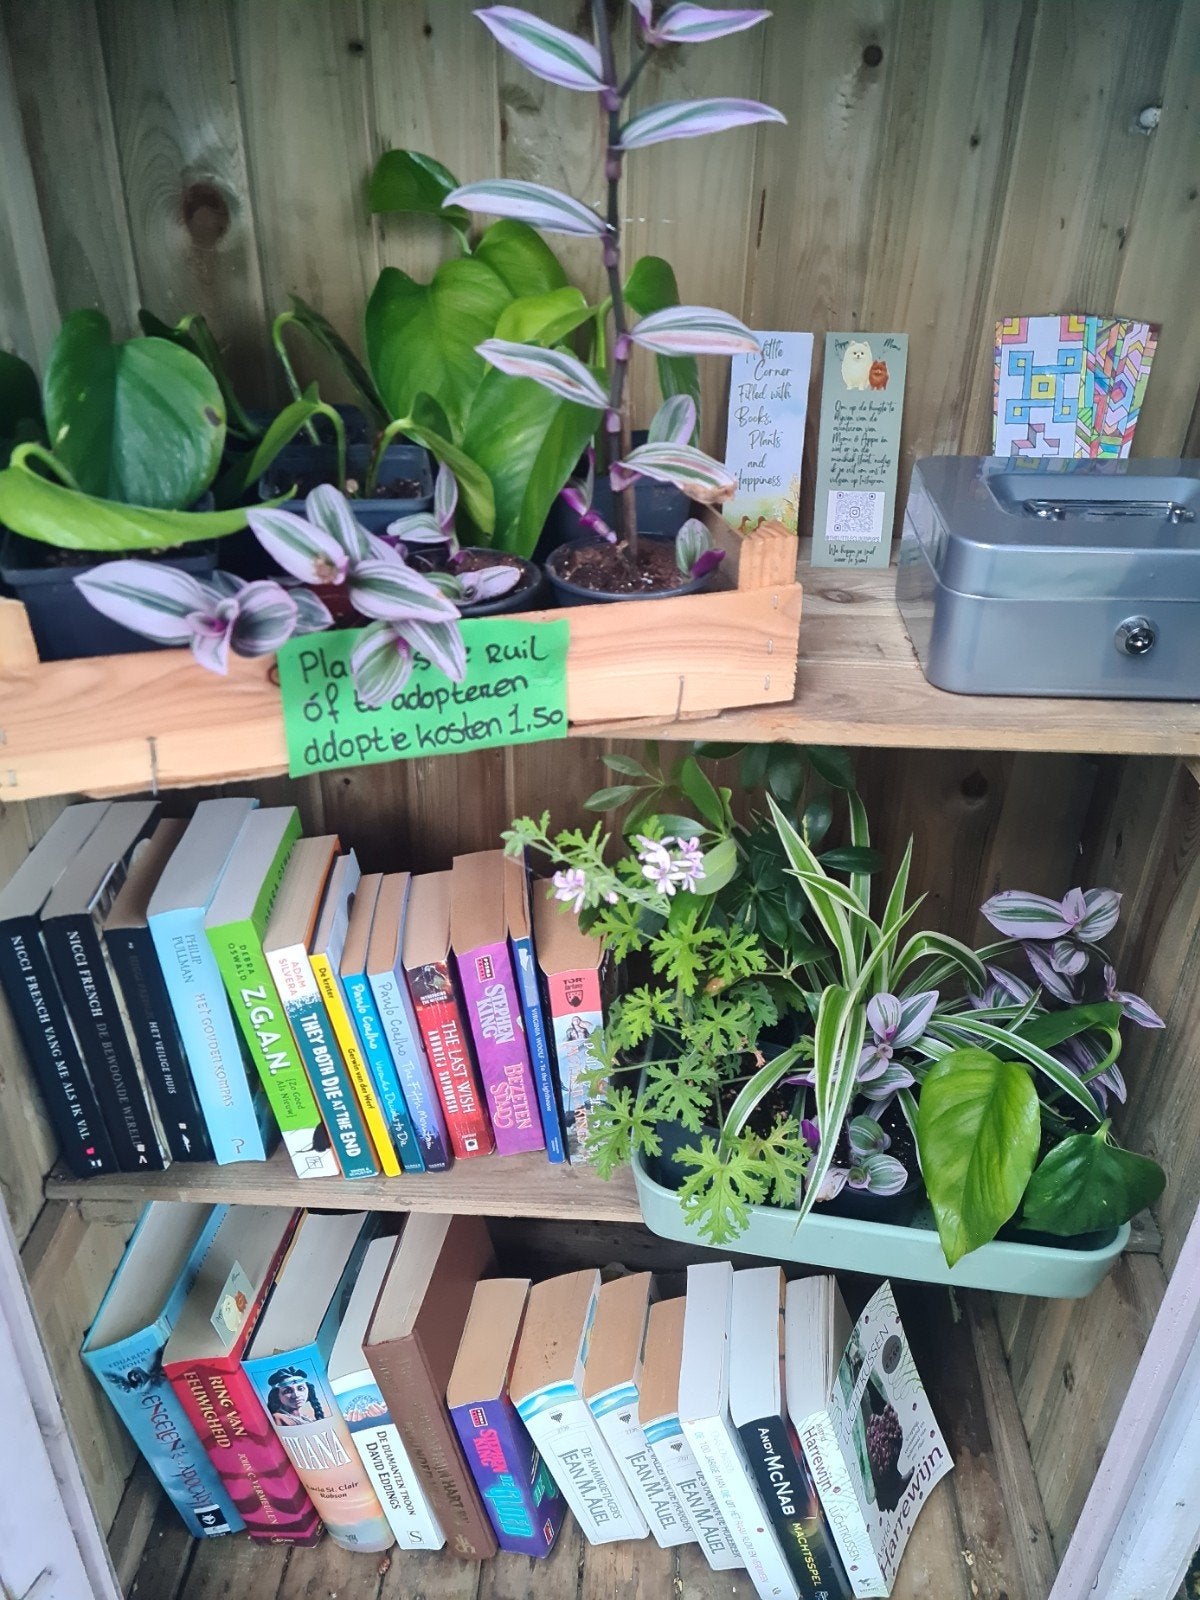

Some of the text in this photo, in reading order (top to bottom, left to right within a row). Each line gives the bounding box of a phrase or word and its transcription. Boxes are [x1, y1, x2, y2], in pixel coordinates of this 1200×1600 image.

[754, 358, 793, 381] Corner
[738, 382, 792, 403] Filled with
[749, 430, 783, 449] Plants
[748, 453, 767, 469] and
[172, 937, 194, 984] PULLMAN
[185, 934, 202, 965] PHILIP
[227, 942, 248, 981] OSWALD
[239, 943, 256, 975] DEBRA
[279, 958, 298, 997] SILVERA
[291, 961, 306, 988] ADAM
[318, 967, 334, 999] De krater
[563, 977, 582, 985] TOR
[66, 931, 130, 1104] NICCI FRENCH DE BEWOONDE
[476, 1000, 498, 1040] KING
[485, 984, 516, 1044] STEPHEN
[11, 935, 90, 1140] NICCI FRENCH VANG ME ALS IK VAL
[240, 984, 291, 1077] Z.G.A.N.
[379, 982, 393, 1015] Paulo
[391, 1019, 406, 1056] Coelho
[401, 1060, 415, 1086] The
[441, 1020, 460, 1048] THE
[531, 1008, 541, 1034] VIRGINIA
[536, 1034, 544, 1059] WOOLF
[540, 1064, 546, 1072] To
[149, 1022, 177, 1094] HET VEILIGE HUIS
[352, 984, 366, 1014] Paulo
[362, 1016, 378, 1050] Coelho
[397, 1130, 409, 1148] Die
[448, 1050, 468, 1077] LAST
[300, 1013, 362, 1158] THEY BOTH DIE AT THE END
[348, 1048, 360, 1073] Gerwin
[364, 1091, 375, 1110] Werf
[457, 1083, 476, 1114] WISH
[504, 1062, 532, 1130] BEZETEN
[108, 1348, 151, 1369] EDUARDO
[184, 1372, 231, 1448] EEUWIGHEID
[209, 1376, 247, 1436] RING VAN
[282, 1426, 353, 1471] TIANA
[581, 1446, 593, 1458] DE
[758, 1428, 775, 1455] ANDY
[376, 1430, 417, 1517] DE DIAMANTEN TROON
[558, 1448, 585, 1480] JEAN
[625, 1450, 654, 1482] JEAN
[802, 1426, 832, 1493] Harrewijn
[338, 1481, 359, 1491] Clair
[366, 1442, 401, 1511] DAVID EDDINGS
[575, 1479, 597, 1498] M.
[643, 1481, 663, 1500] M.
[676, 1478, 701, 1508] JEAN
[584, 1498, 610, 1527] AUEL
[651, 1500, 676, 1530] AUEL
[692, 1508, 714, 1526] M.
[880, 1446, 944, 1582] Harrewijn
[700, 1526, 726, 1555] AUEL
[829, 1505, 862, 1562] LUCHTKUSSEN
[793, 1522, 822, 1586] MACHTSSPEL
